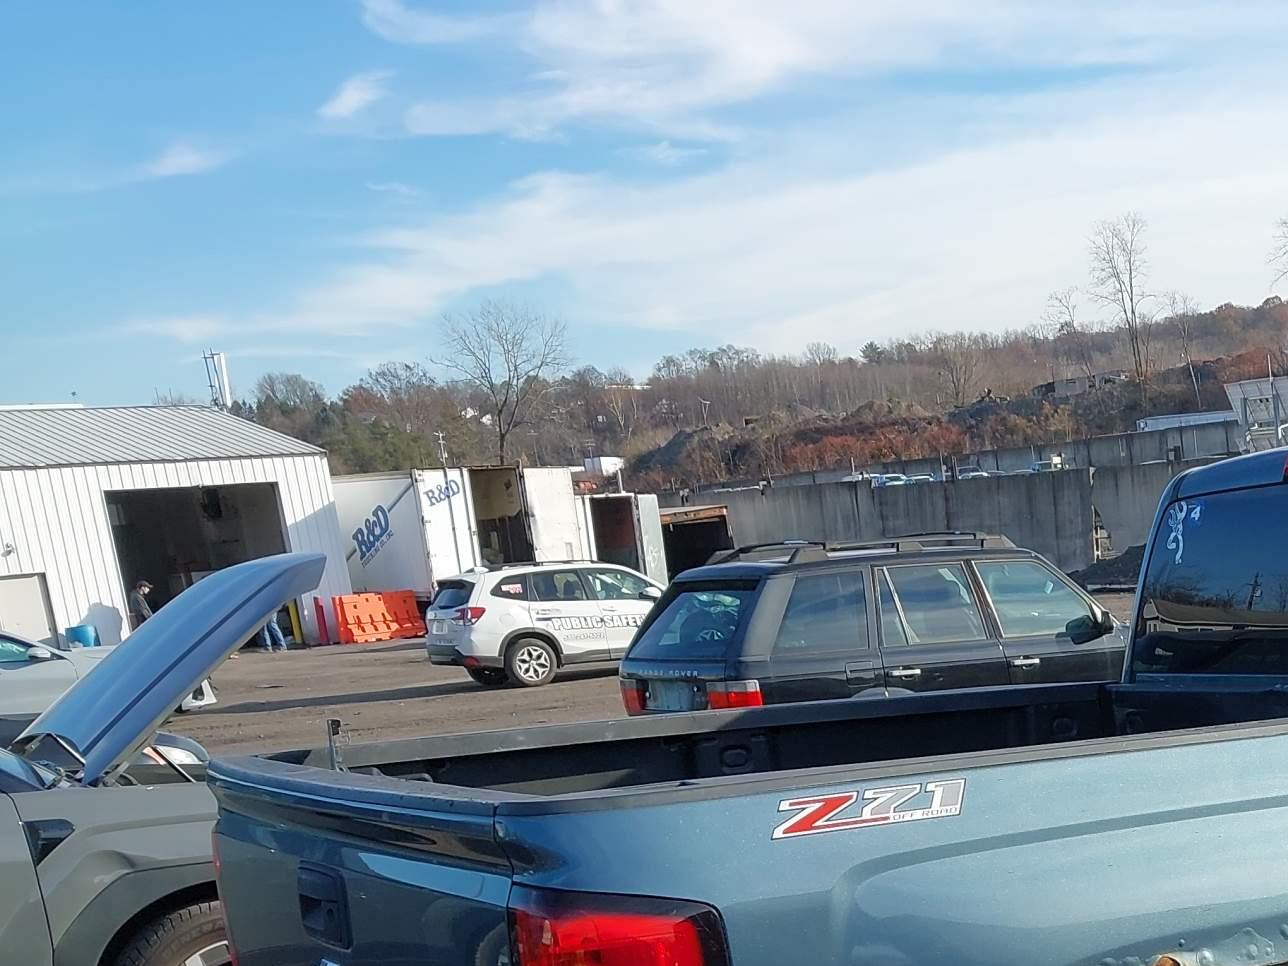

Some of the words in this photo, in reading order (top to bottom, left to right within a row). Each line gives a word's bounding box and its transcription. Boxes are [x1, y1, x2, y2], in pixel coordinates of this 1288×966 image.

[424, 479, 460, 506] R&D
[352, 504, 390, 561] R&D
[551, 616, 603, 630] PUBLIC
[668, 669, 699, 677] ROVER
[771, 778, 966, 840] Z71
[892, 812, 917, 821] OFF
[921, 806, 958, 817] ROAD
